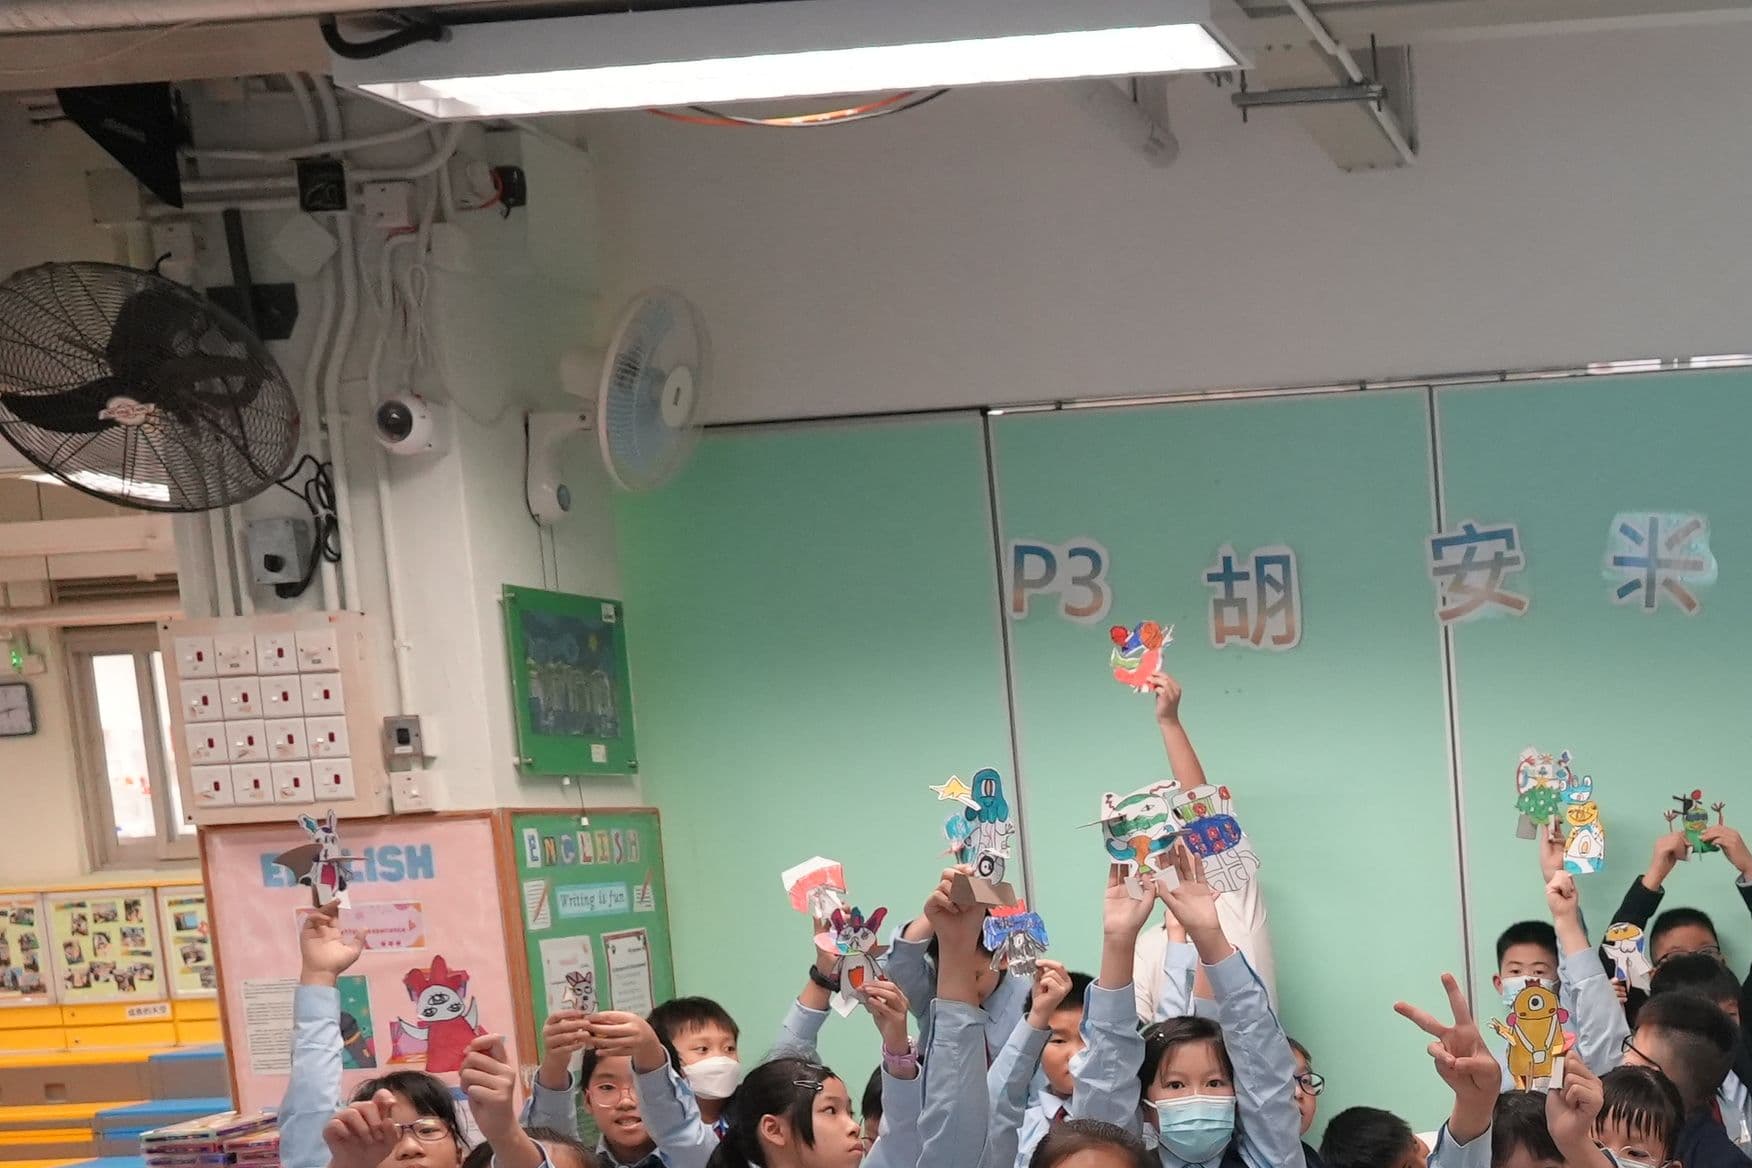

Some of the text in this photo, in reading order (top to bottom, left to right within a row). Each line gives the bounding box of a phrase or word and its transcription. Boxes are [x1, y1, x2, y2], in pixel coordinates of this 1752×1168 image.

[1012, 545, 1105, 617] P3
[260, 844, 434, 888] ELISH
[560, 889, 625, 911] Writing is fun
